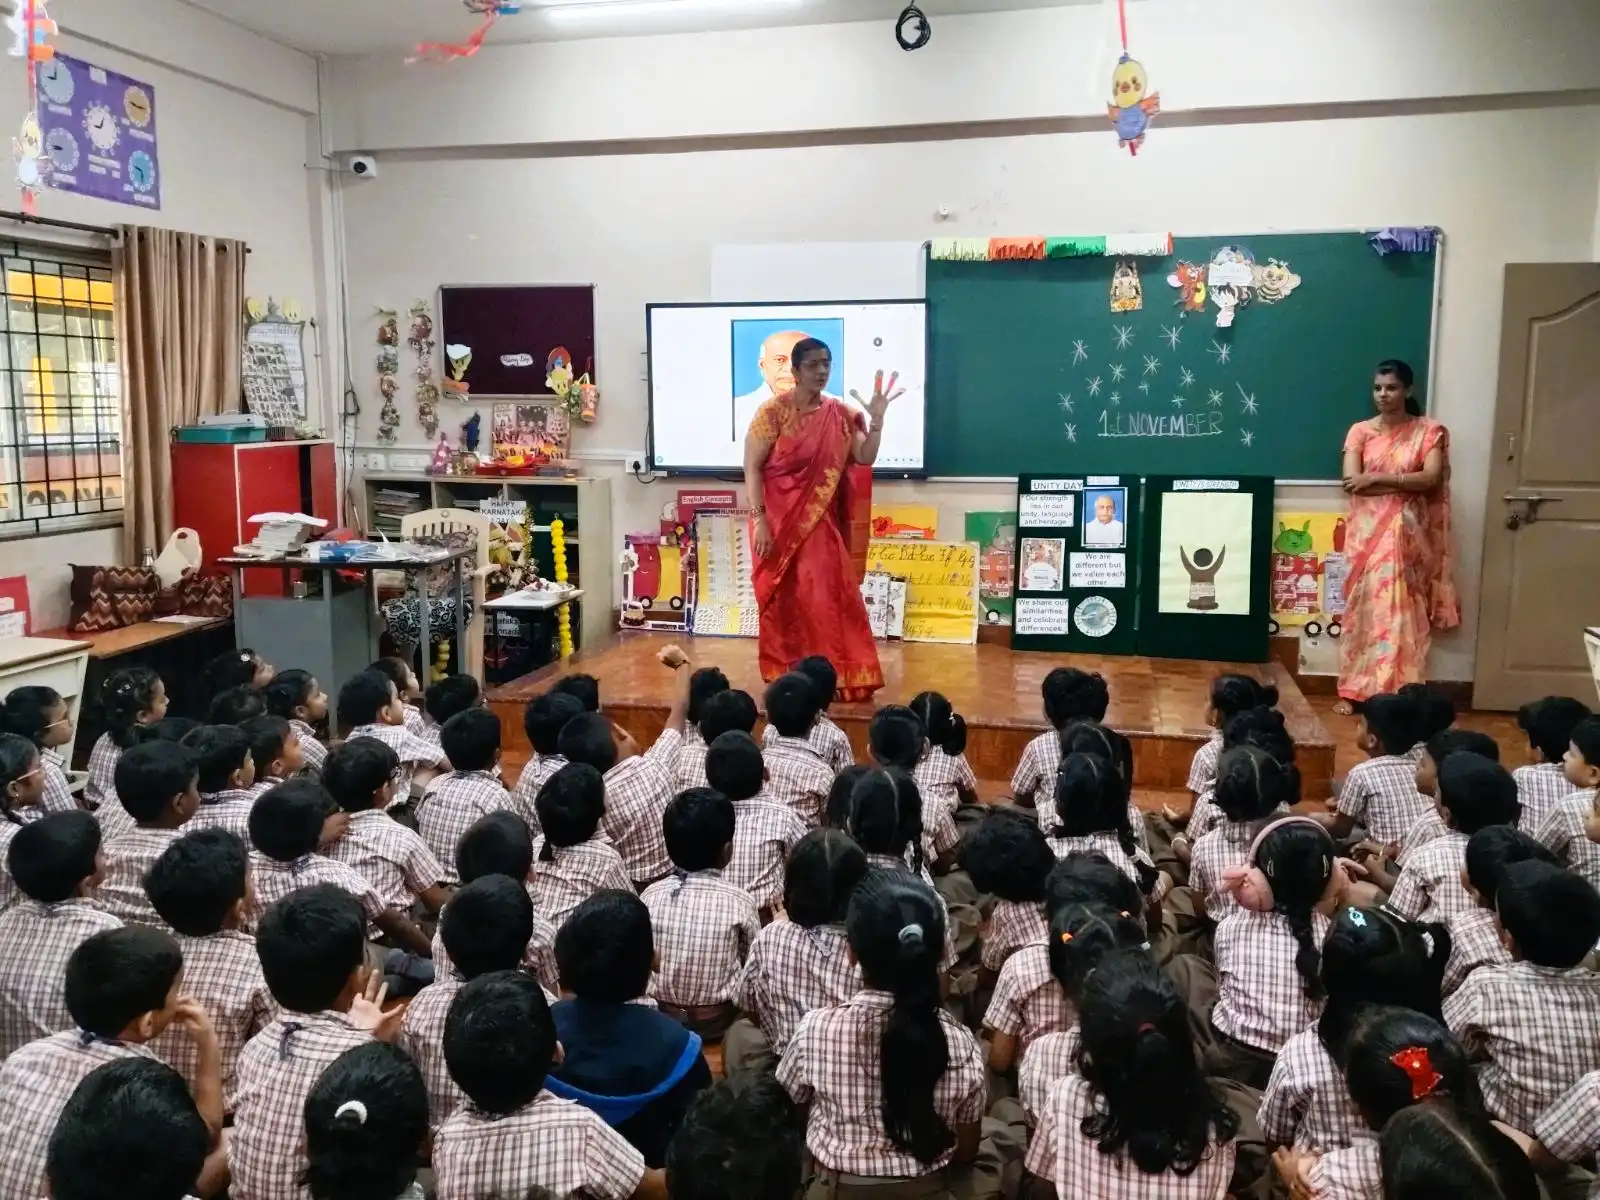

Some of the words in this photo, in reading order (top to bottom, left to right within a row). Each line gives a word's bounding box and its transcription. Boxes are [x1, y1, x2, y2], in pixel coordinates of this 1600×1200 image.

[1128, 410, 1223, 437] NOVEMBER
[1033, 482, 1060, 490] UNITY
[1063, 482, 1083, 490] DAY
[682, 496, 703, 504] English
[1040, 494, 1069, 502] strength
